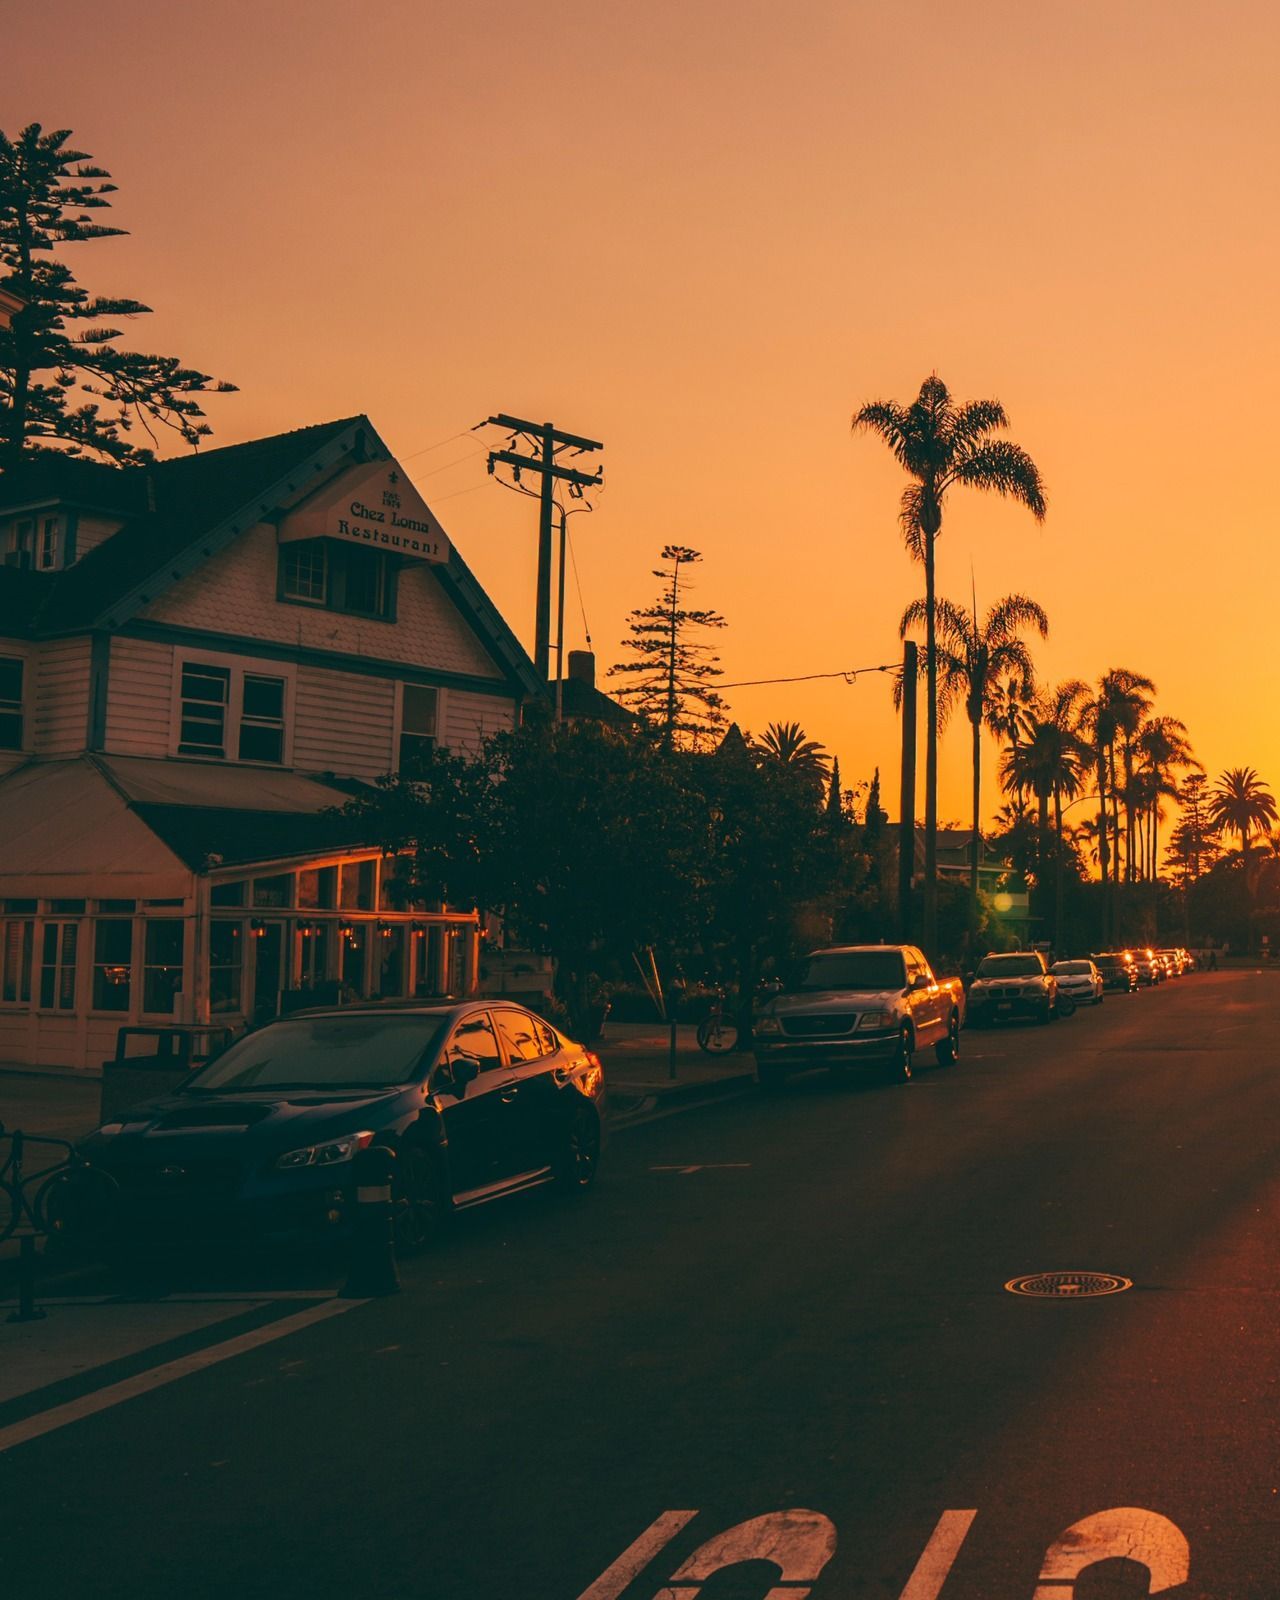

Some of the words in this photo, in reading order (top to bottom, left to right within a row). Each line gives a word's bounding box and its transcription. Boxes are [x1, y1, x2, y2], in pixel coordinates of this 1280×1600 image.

[350, 501, 385, 523] Chez
[391, 512, 429, 533] Loma
[338, 519, 439, 555] Restaurant
